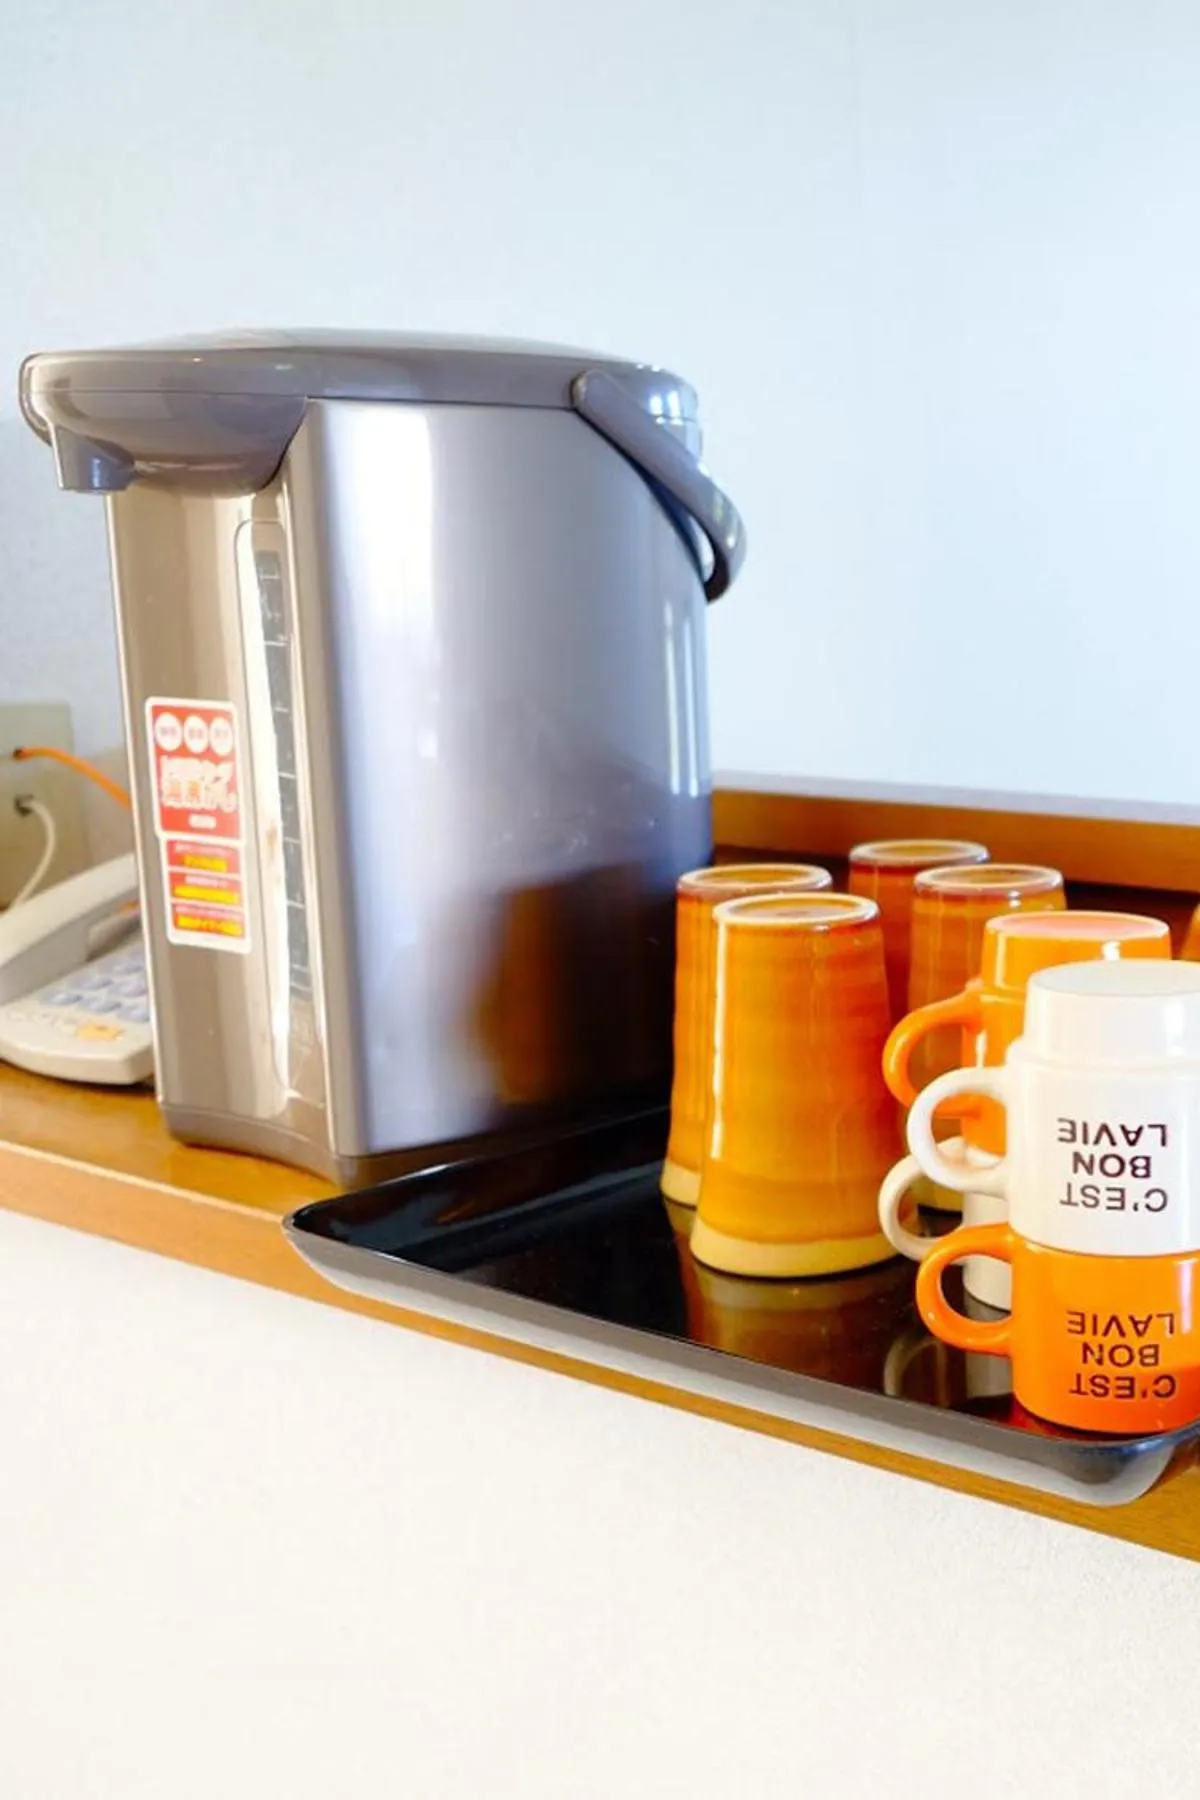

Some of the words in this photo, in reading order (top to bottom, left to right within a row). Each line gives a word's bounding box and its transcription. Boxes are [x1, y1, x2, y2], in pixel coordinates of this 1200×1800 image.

[1072, 1152, 1152, 1178] BON
[1059, 1183, 1168, 1212] C'EST
[1082, 1342, 1159, 1368] BON
[1069, 1373, 1177, 1399] C'EST
